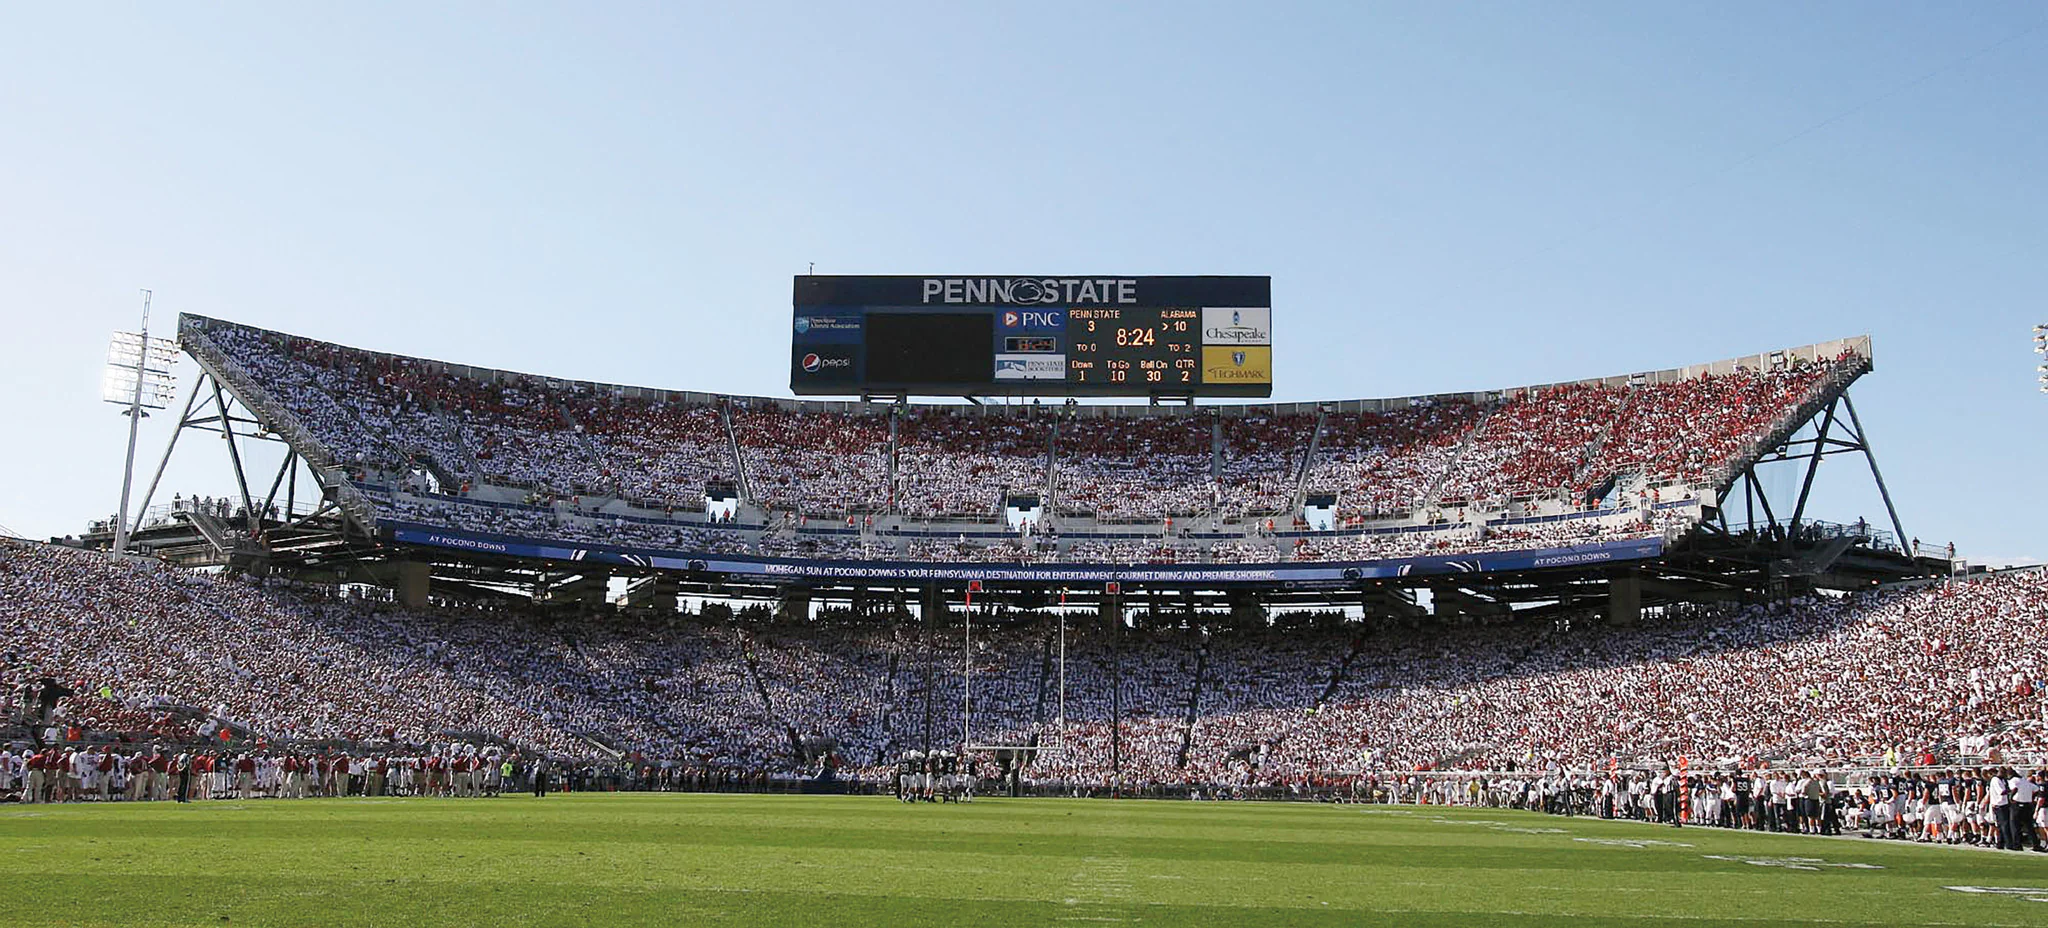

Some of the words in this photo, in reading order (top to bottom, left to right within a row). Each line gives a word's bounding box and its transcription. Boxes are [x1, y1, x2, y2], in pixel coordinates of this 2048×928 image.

[923, 279, 1011, 303] PENN
[1042, 279, 1137, 303] STATE
[1022, 312, 1060, 326] PNC
[1069, 310, 1092, 319] PENN
[1094, 310, 1120, 319] STATE
[1161, 310, 1197, 319] ALABAMA
[1088, 320, 1095, 332] 3
[1174, 321, 1187, 332] 10
[1117, 328, 1155, 346] 8:24
[1206, 327, 1266, 343] Chesapeake
[1076, 344, 1088, 352] TO
[1168, 344, 1180, 352] TO
[1185, 344, 1191, 352] 2
[821, 358, 850, 368] pepsi
[1071, 360, 1093, 369] Down
[1107, 360, 1117, 369] To
[1118, 360, 1130, 369] Go
[1140, 360, 1154, 369] Ball
[1156, 360, 1168, 369] On
[1175, 359, 1195, 369] QTR
[1079, 371, 1085, 381] 1
[1111, 371, 1125, 381] 10
[1146, 371, 1161, 381] 30
[1181, 371, 1189, 381] 2
[442, 537, 476, 547] POCONO
[477, 542, 506, 552] DOWNS
[1546, 555, 1580, 565] POCONO
[1581, 552, 1611, 561] DOWNS
[765, 564, 805, 575] MOHEGAN
[806, 566, 822, 576] SUN
[823, 567, 835, 576] AT
[835, 568, 868, 577] POCONO
[868, 568, 898, 577] DOWNS
[899, 569, 906, 577] IS
[906, 569, 928, 578] YOUR
[929, 569, 985, 579] PENNSYLVANIA
[986, 570, 1035, 580] DESTINATION
[1036, 571, 1051, 580] FOR
[1052, 571, 1114, 580] ENTERTAINMENT
[1116, 571, 1153, 580] GOURMET
[1154, 571, 1182, 580] DINING
[1183, 571, 1201, 580] AND
[1202, 571, 1235, 580] PREMIER
